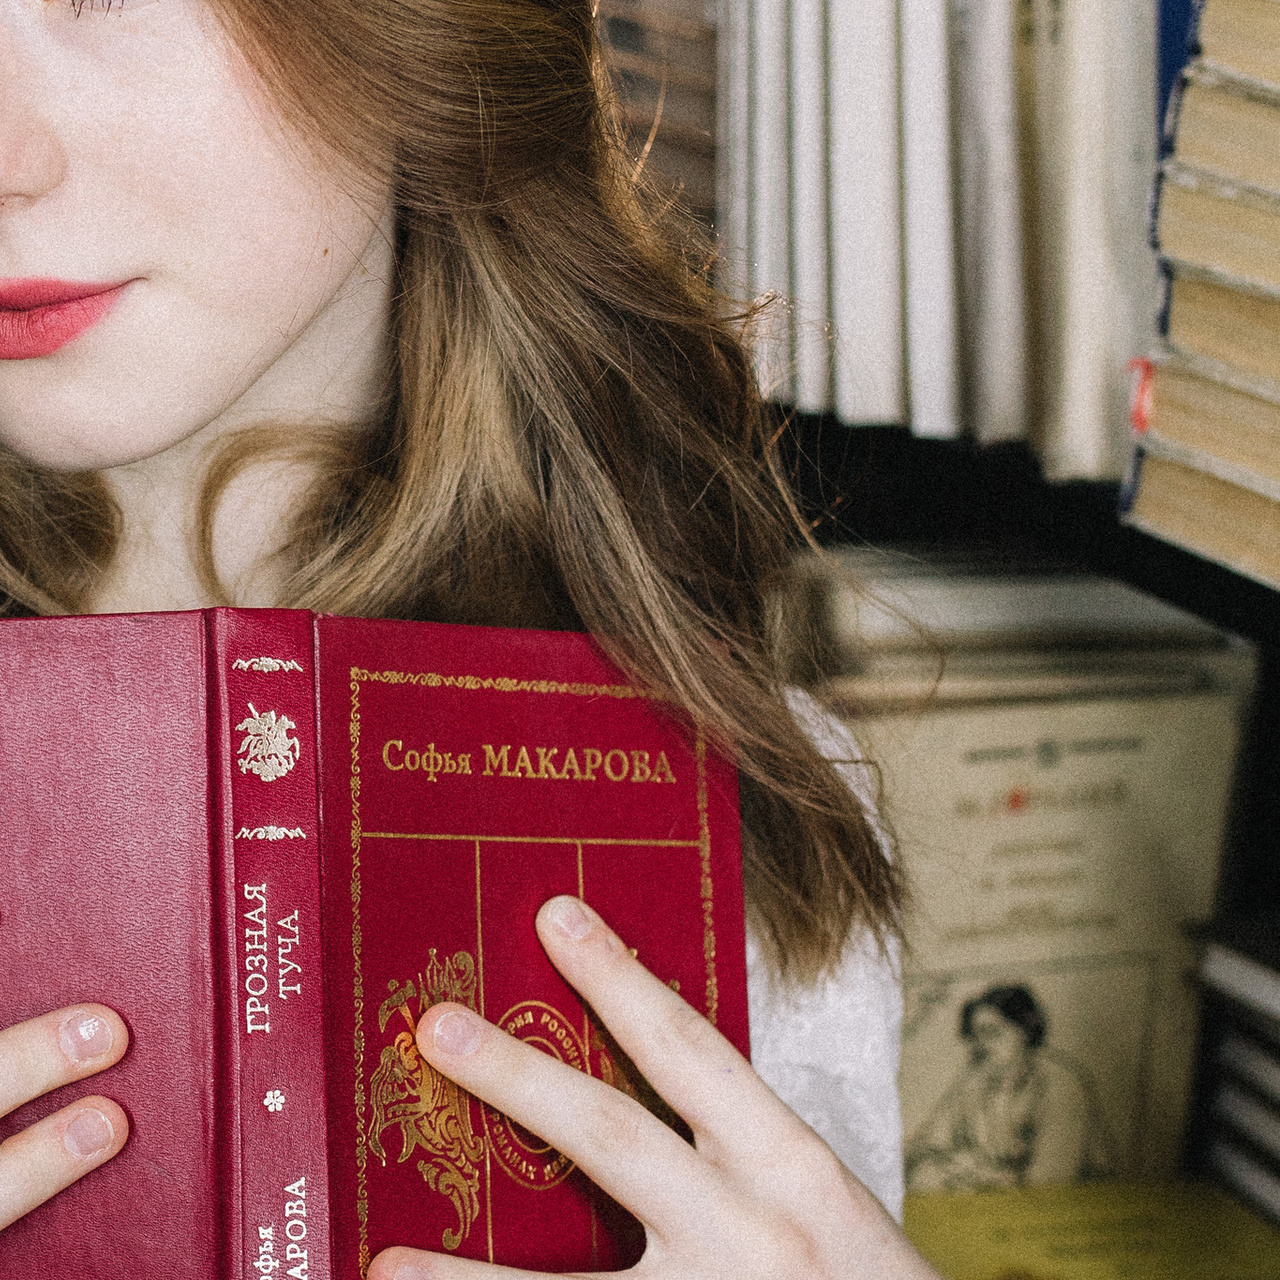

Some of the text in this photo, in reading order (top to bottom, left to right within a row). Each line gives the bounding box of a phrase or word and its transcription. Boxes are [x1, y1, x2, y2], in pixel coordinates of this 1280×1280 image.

[381, 739, 677, 784] Софья МАКАРОВА
[243, 883, 270, 1034] ГРОЗНАЯ
[277, 909, 302, 1000] ТУЧА
